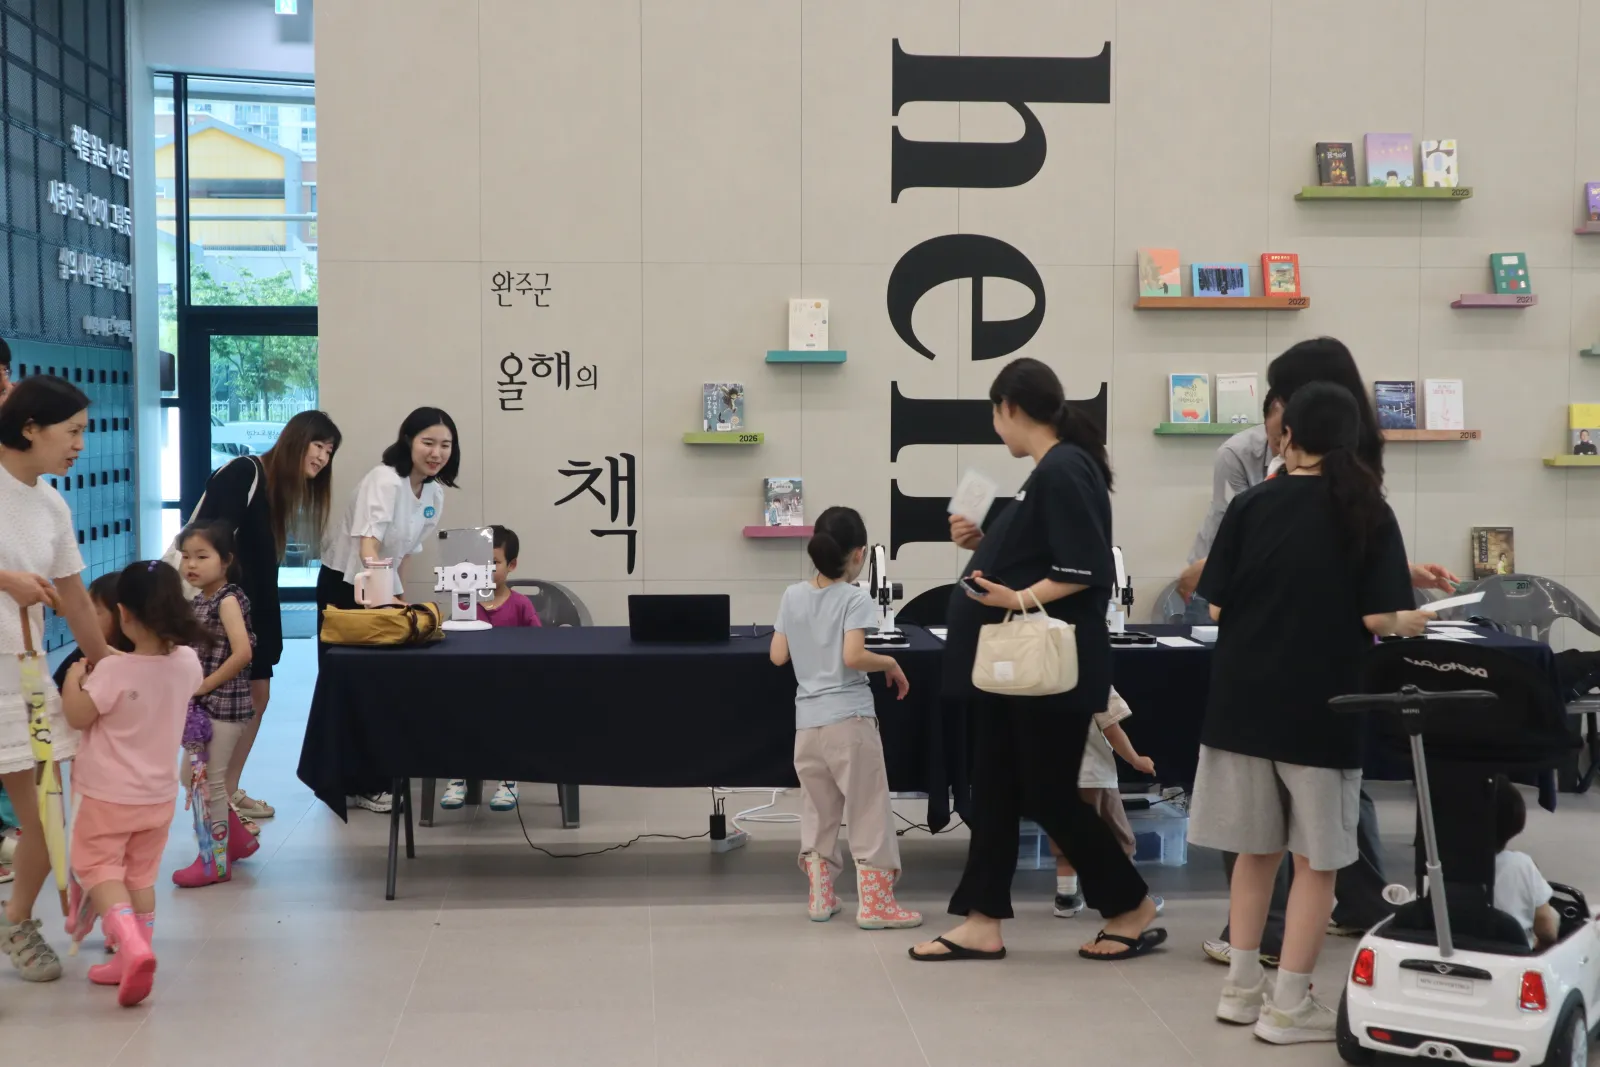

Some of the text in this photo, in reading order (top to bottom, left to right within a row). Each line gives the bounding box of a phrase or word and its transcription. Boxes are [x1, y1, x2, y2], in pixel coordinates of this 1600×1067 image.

[71, 124, 131, 180] 책을 읽는 시간은
[47, 179, 84, 221] 사랑하는
[83, 193, 109, 229] 시간이
[1451, 188, 1470, 197] 2023
[77, 252, 104, 288] 시간을
[491, 270, 552, 307] 완주군
[1288, 297, 1306, 306] 2022
[1516, 296, 1533, 304] 2021
[497, 350, 598, 411] 올해의
[739, 434, 758, 443] 2026
[1459, 431, 1477, 440] 2016
[554, 453, 638, 575] 책
